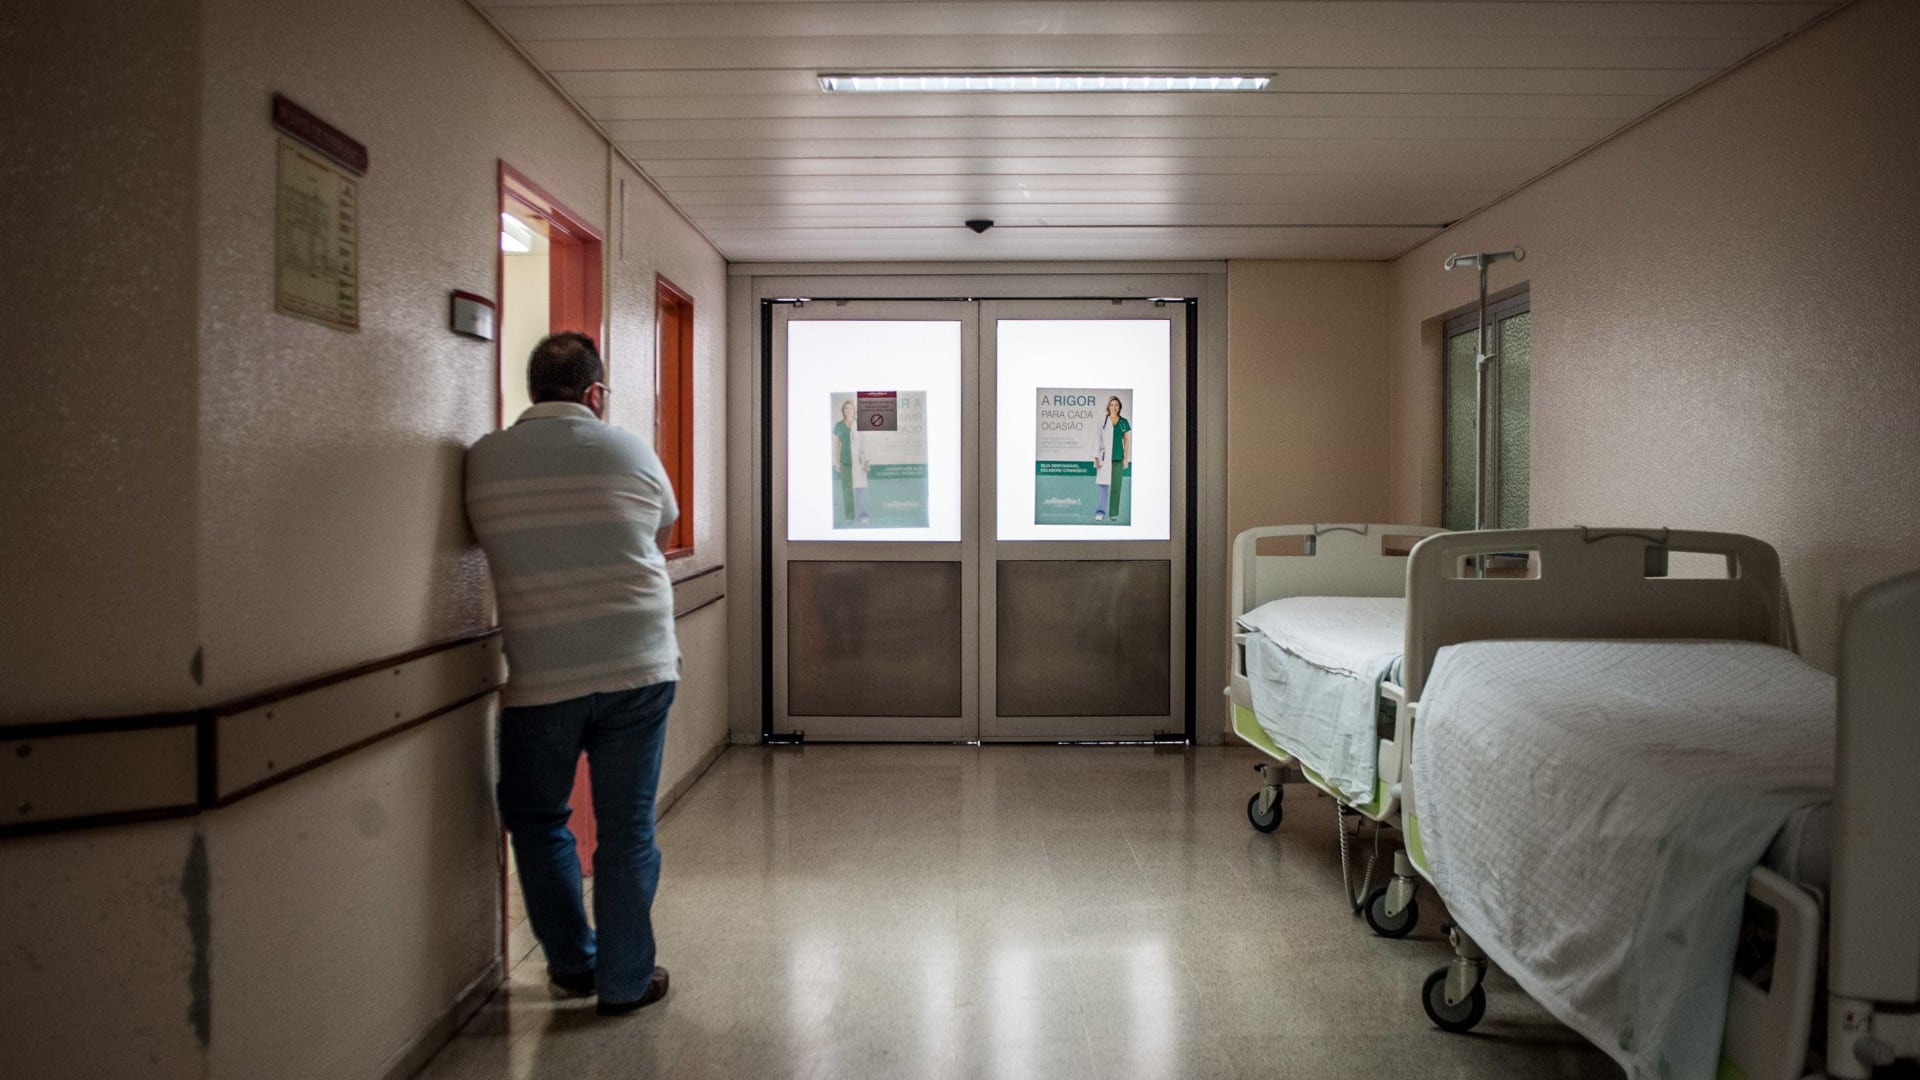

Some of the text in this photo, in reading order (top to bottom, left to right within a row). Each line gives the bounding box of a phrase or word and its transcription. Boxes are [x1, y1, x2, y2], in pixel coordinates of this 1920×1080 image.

[1041, 395, 1096, 406] A RIGOR
[1041, 410, 1094, 419] PARA CADA
[1041, 420, 1083, 431] OCASIÃO
